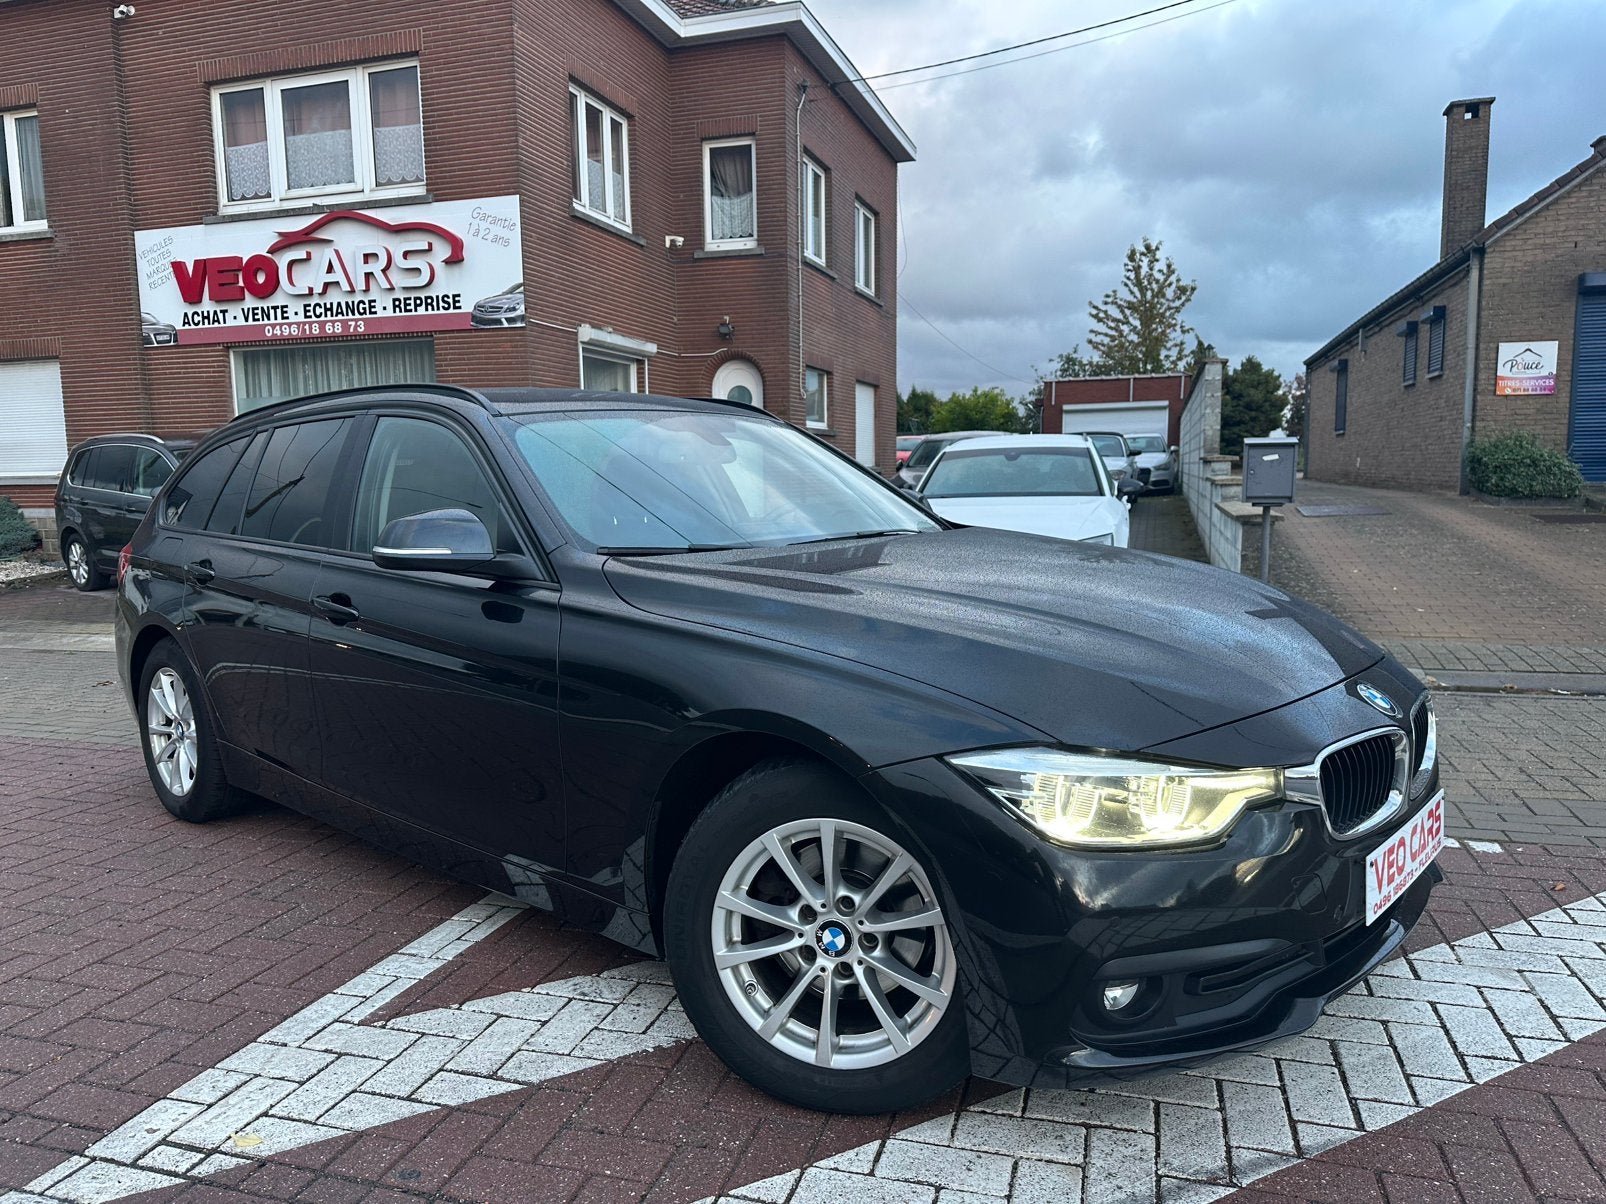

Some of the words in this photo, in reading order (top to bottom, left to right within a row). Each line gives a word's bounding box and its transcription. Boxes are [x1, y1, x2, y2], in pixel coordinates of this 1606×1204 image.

[471, 206, 517, 231] Garantie
[467, 222, 472, 234] 1
[472, 222, 481, 237] à
[481, 227, 491, 241] 2
[490, 234, 512, 247] ans
[138, 236, 173, 259] VEHICULES
[147, 248, 172, 267] TOUTES
[170, 253, 279, 304] VEO
[277, 240, 435, 296] CARS
[182, 308, 229, 327] ACHAT
[241, 304, 290, 323] VENTE
[303, 299, 378, 319] ECHANGE
[392, 293, 463, 314] REPRISE
[265, 324, 320, 338] 0496/18
[325, 323, 342, 335] 68
[348, 321, 366, 334] 73
[1503, 358, 1544, 373] Pouce
[1373, 836, 1406, 895] VEO
[1410, 799, 1442, 863] CARS
